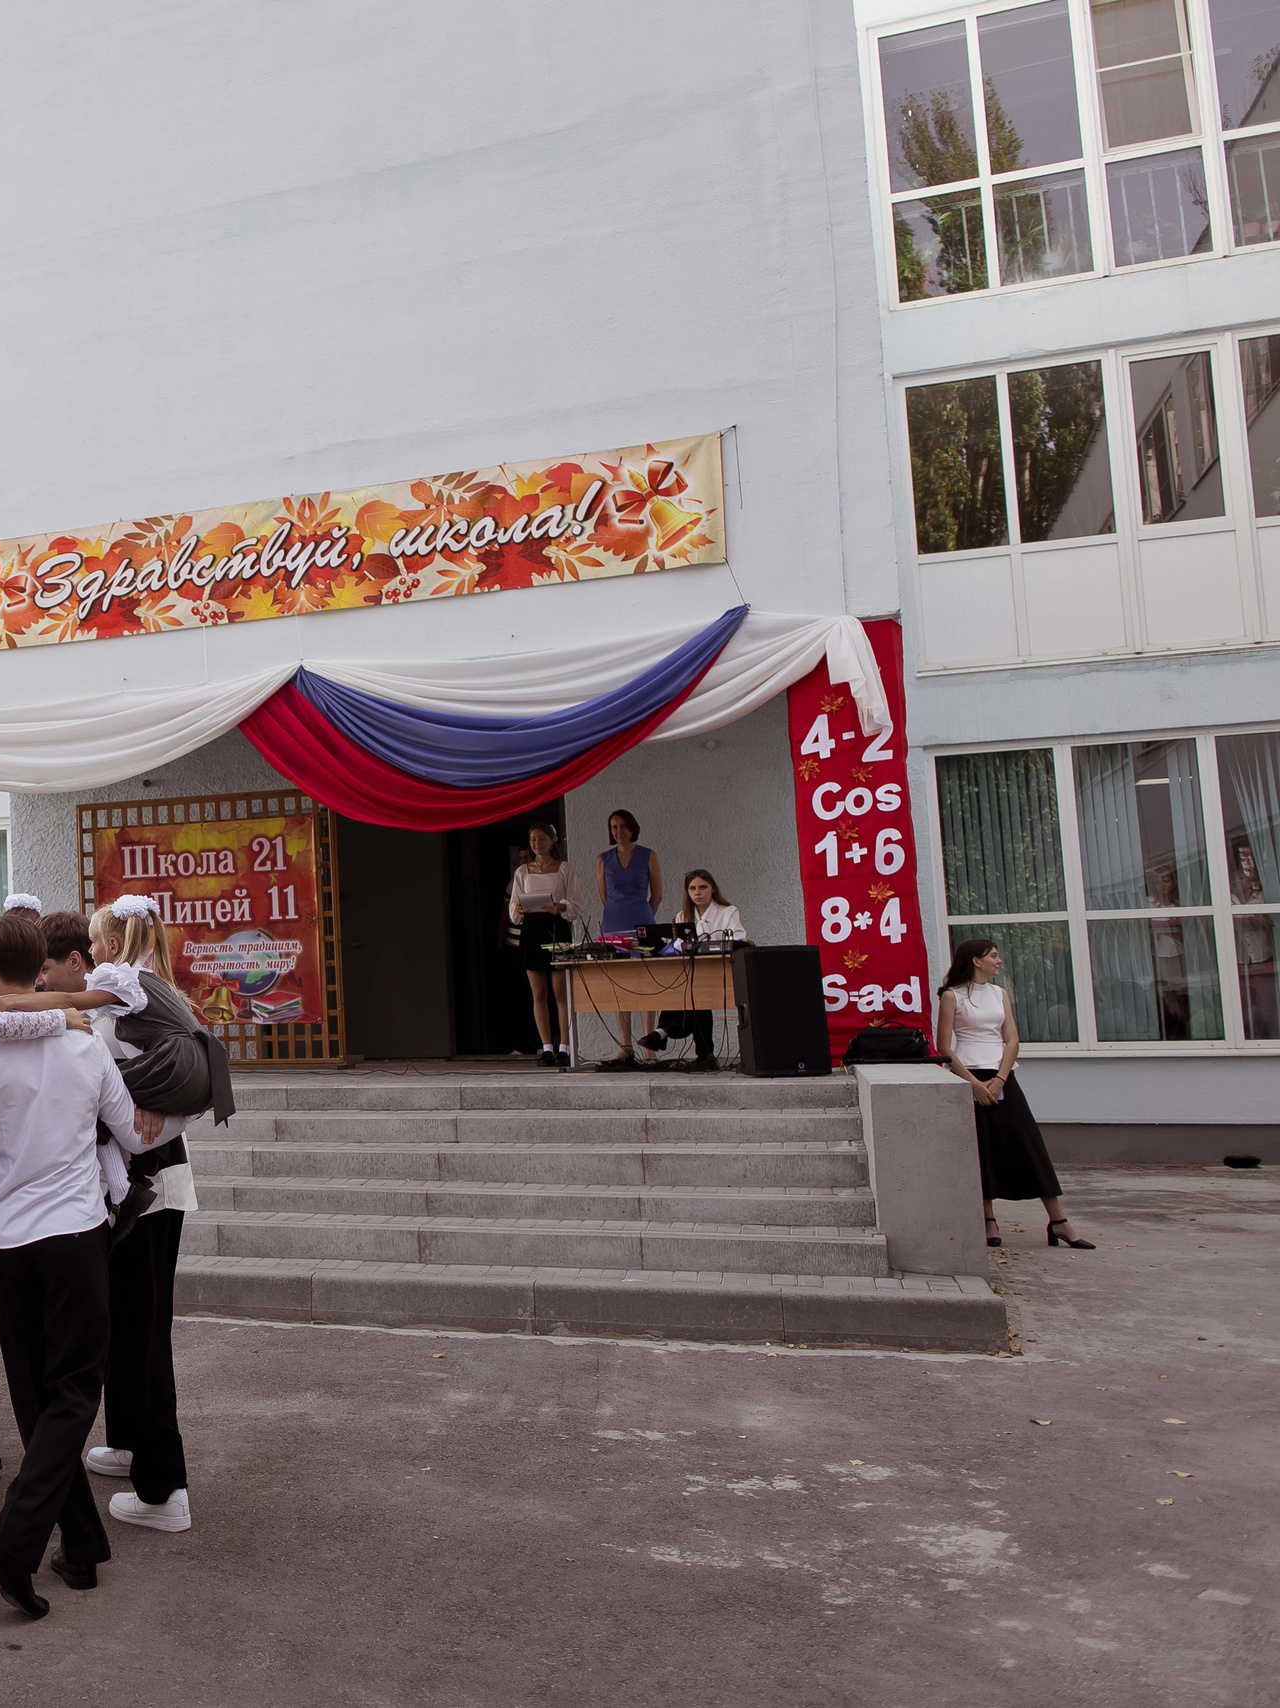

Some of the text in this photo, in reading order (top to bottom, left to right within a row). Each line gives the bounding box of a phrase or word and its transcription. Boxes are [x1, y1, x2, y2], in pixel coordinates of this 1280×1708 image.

[33, 480, 603, 619] Здравствуй, школа!
[811, 781, 902, 821] Cos
[121, 836, 287, 879] Школа 21
[267, 885, 298, 920] 11
[184, 940, 302, 957] Верность традициям,
[192, 957, 296, 974] открытость миру!
